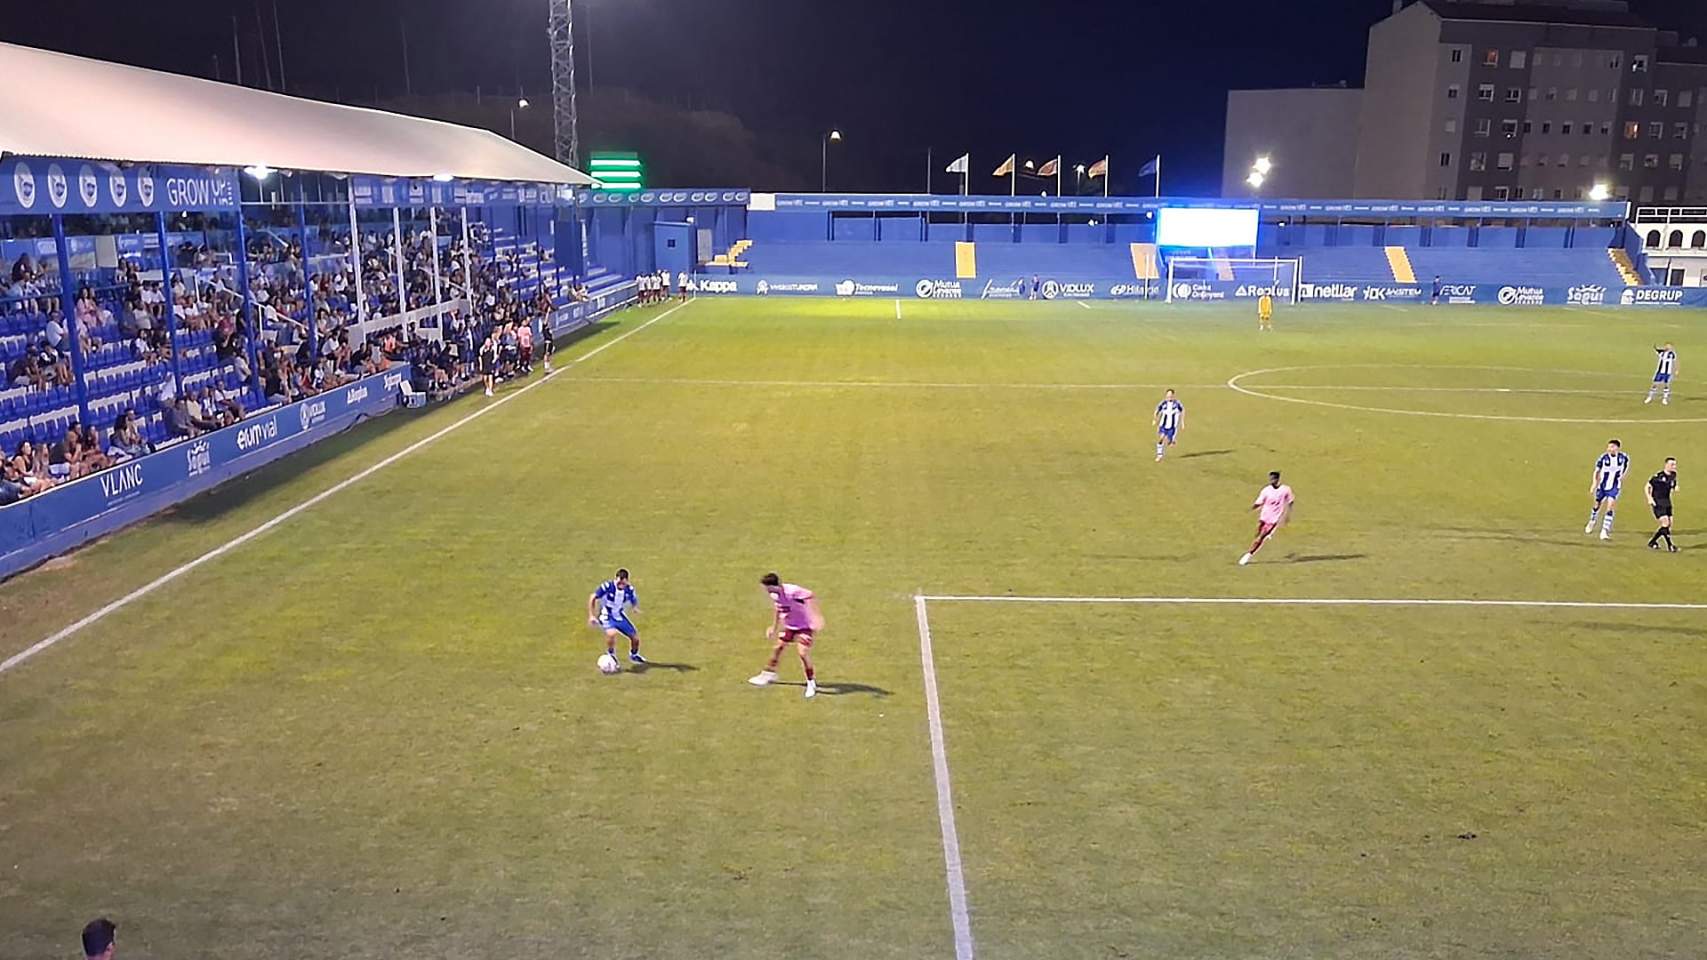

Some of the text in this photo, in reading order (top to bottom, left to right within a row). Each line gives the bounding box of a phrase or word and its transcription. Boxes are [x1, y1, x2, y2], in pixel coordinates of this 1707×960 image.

[166, 178, 209, 206] GROW
[700, 279, 737, 293] Kappa
[1636, 289, 1683, 301] DEGRUP
